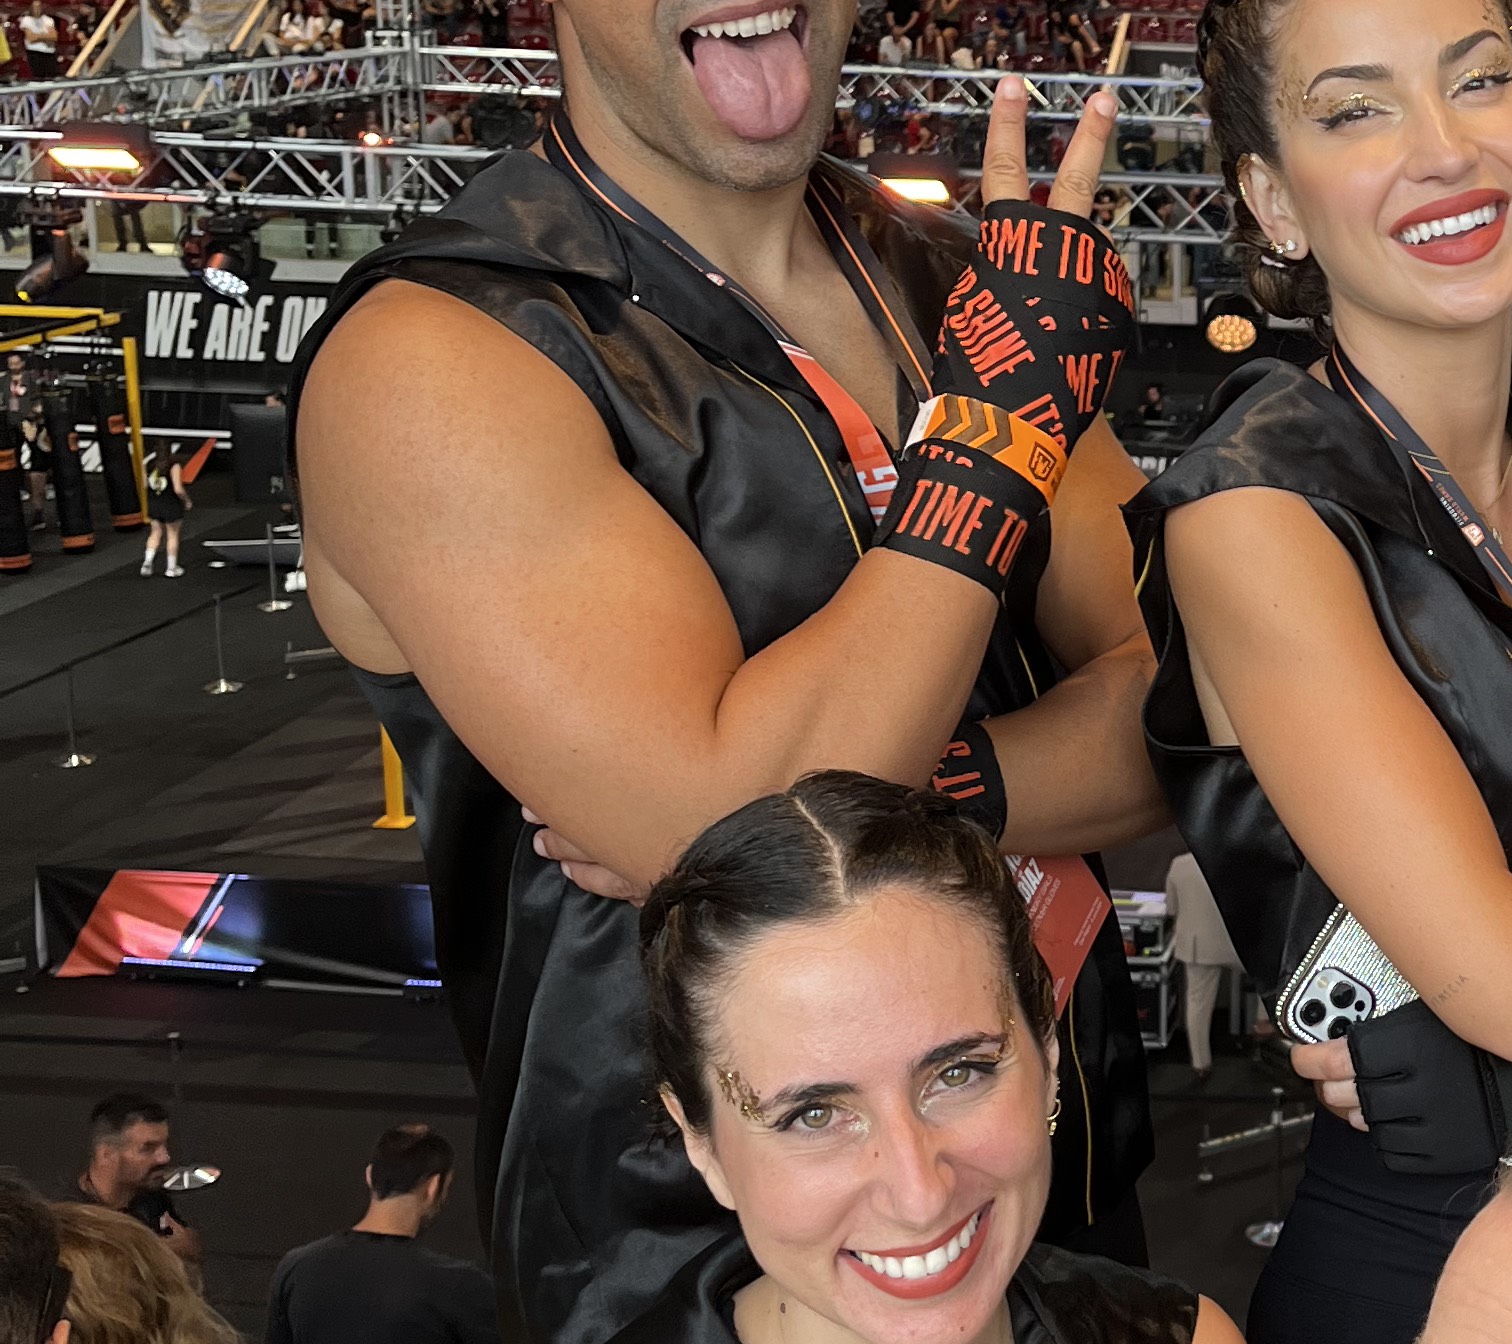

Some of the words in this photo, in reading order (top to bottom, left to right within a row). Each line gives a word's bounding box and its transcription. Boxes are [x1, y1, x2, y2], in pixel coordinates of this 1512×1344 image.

[1058, 224, 1096, 284] TO
[145, 290, 202, 358] WE
[203, 295, 275, 362] ARE
[949, 289, 1036, 388] SHINE
[895, 479, 993, 555] TIME
[985, 507, 1028, 577] TO
